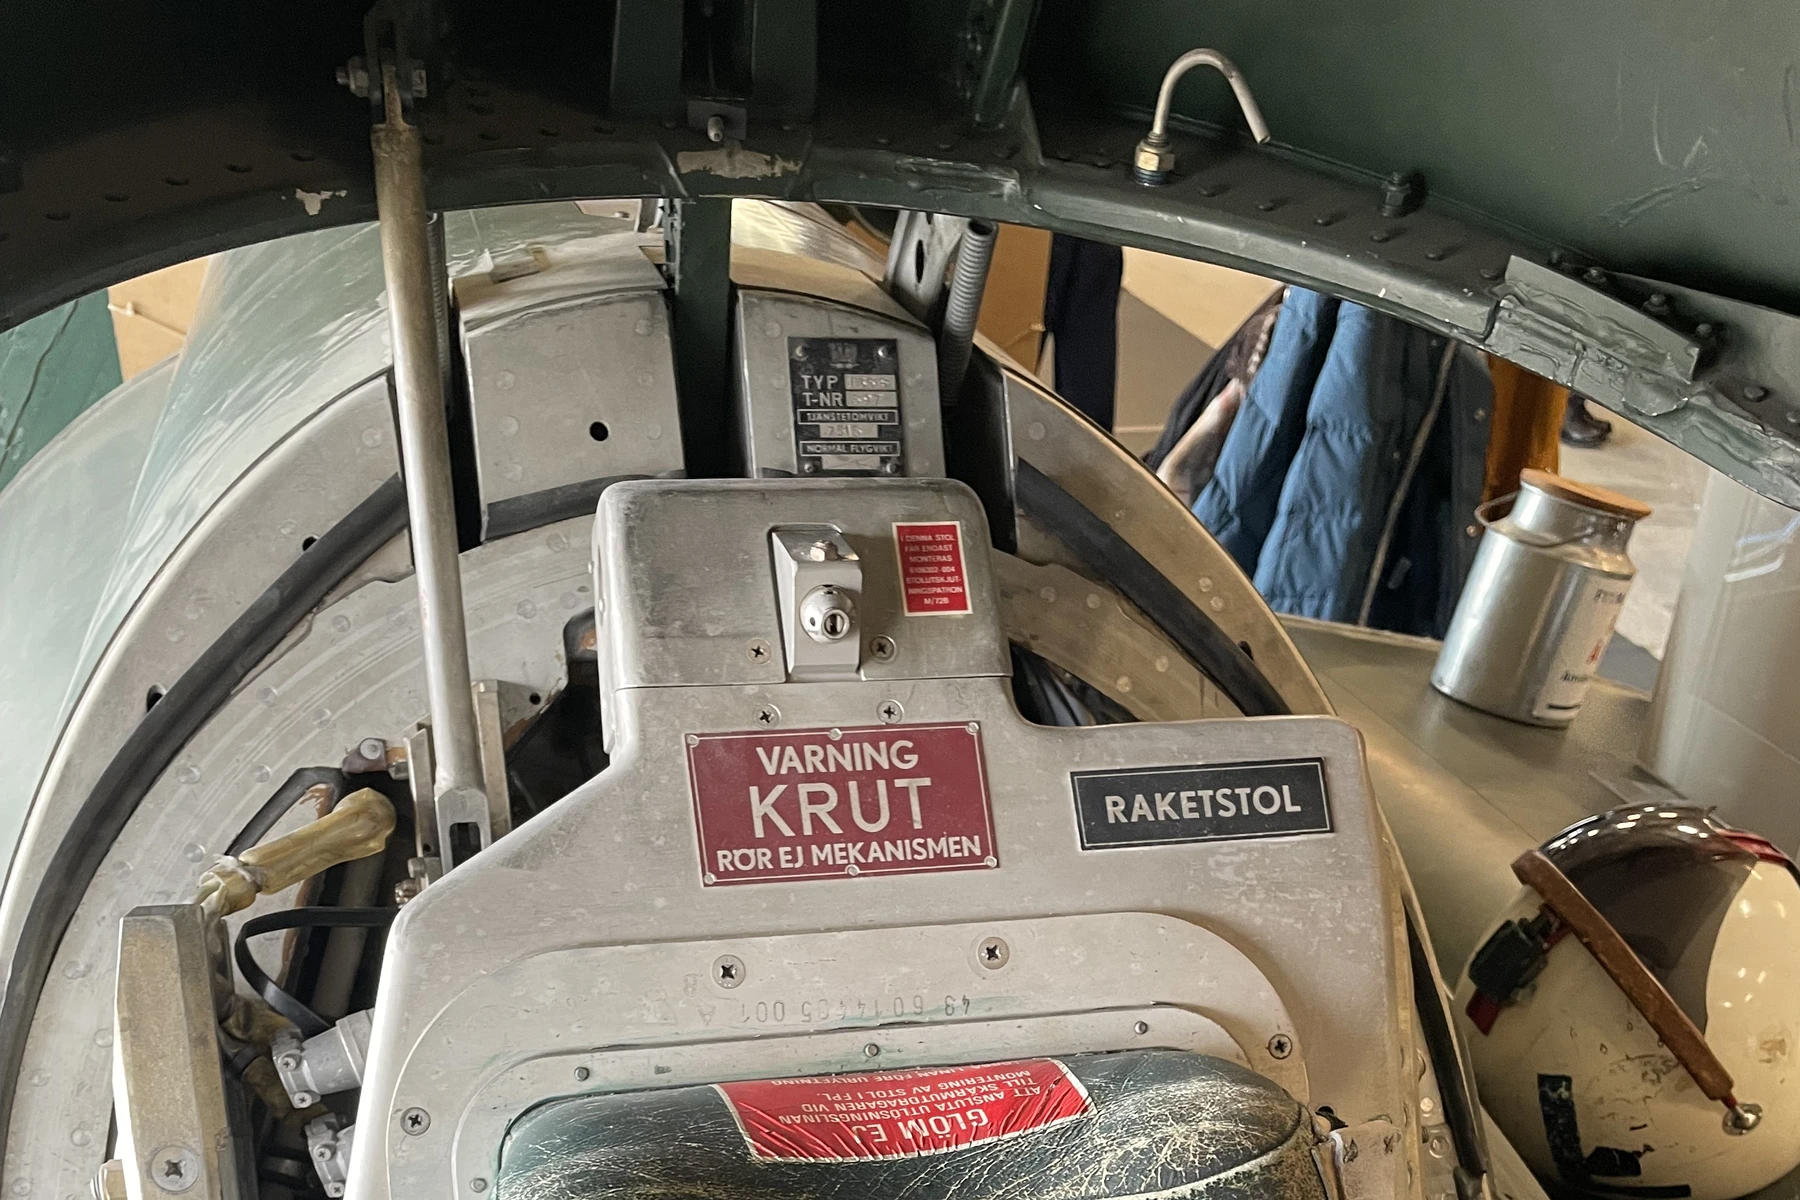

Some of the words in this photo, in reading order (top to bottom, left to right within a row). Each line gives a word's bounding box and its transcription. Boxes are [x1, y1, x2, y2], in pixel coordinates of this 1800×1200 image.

[801, 374, 838, 389] TYP
[802, 391, 844, 407] T-NR
[806, 444, 847, 453] NORMAL
[850, 444, 893, 453] FLYGVIKT
[905, 534, 933, 542] DENNA
[922, 544, 953, 552] ENDAST
[756, 740, 919, 775] VARNING
[749, 777, 932, 838] KRUT
[1104, 784, 1301, 824] RAKETSTOL
[717, 848, 774, 872] RÖR
[779, 846, 804, 868] EJ
[811, 835, 981, 866] MEKANISMEN
[938, 1070, 1031, 1090] MONTERING
[1003, 1079, 1037, 1088] TILL
[817, 1093, 852, 1101] FPL.
[835, 1083, 999, 1111] SKÄRMUTDRAGAREN
[866, 1088, 906, 1099] STOL
[912, 1085, 931, 1094] AV
[1014, 1086, 1041, 1097] ATT
[801, 1103, 829, 1113] VID
[935, 1091, 1005, 1112] ANSLUTA
[779, 1105, 931, 1124] UTLÖSNINGSLINAN
[898, 1108, 988, 1139] GLÖM
[851, 1123, 888, 1144] EJ
